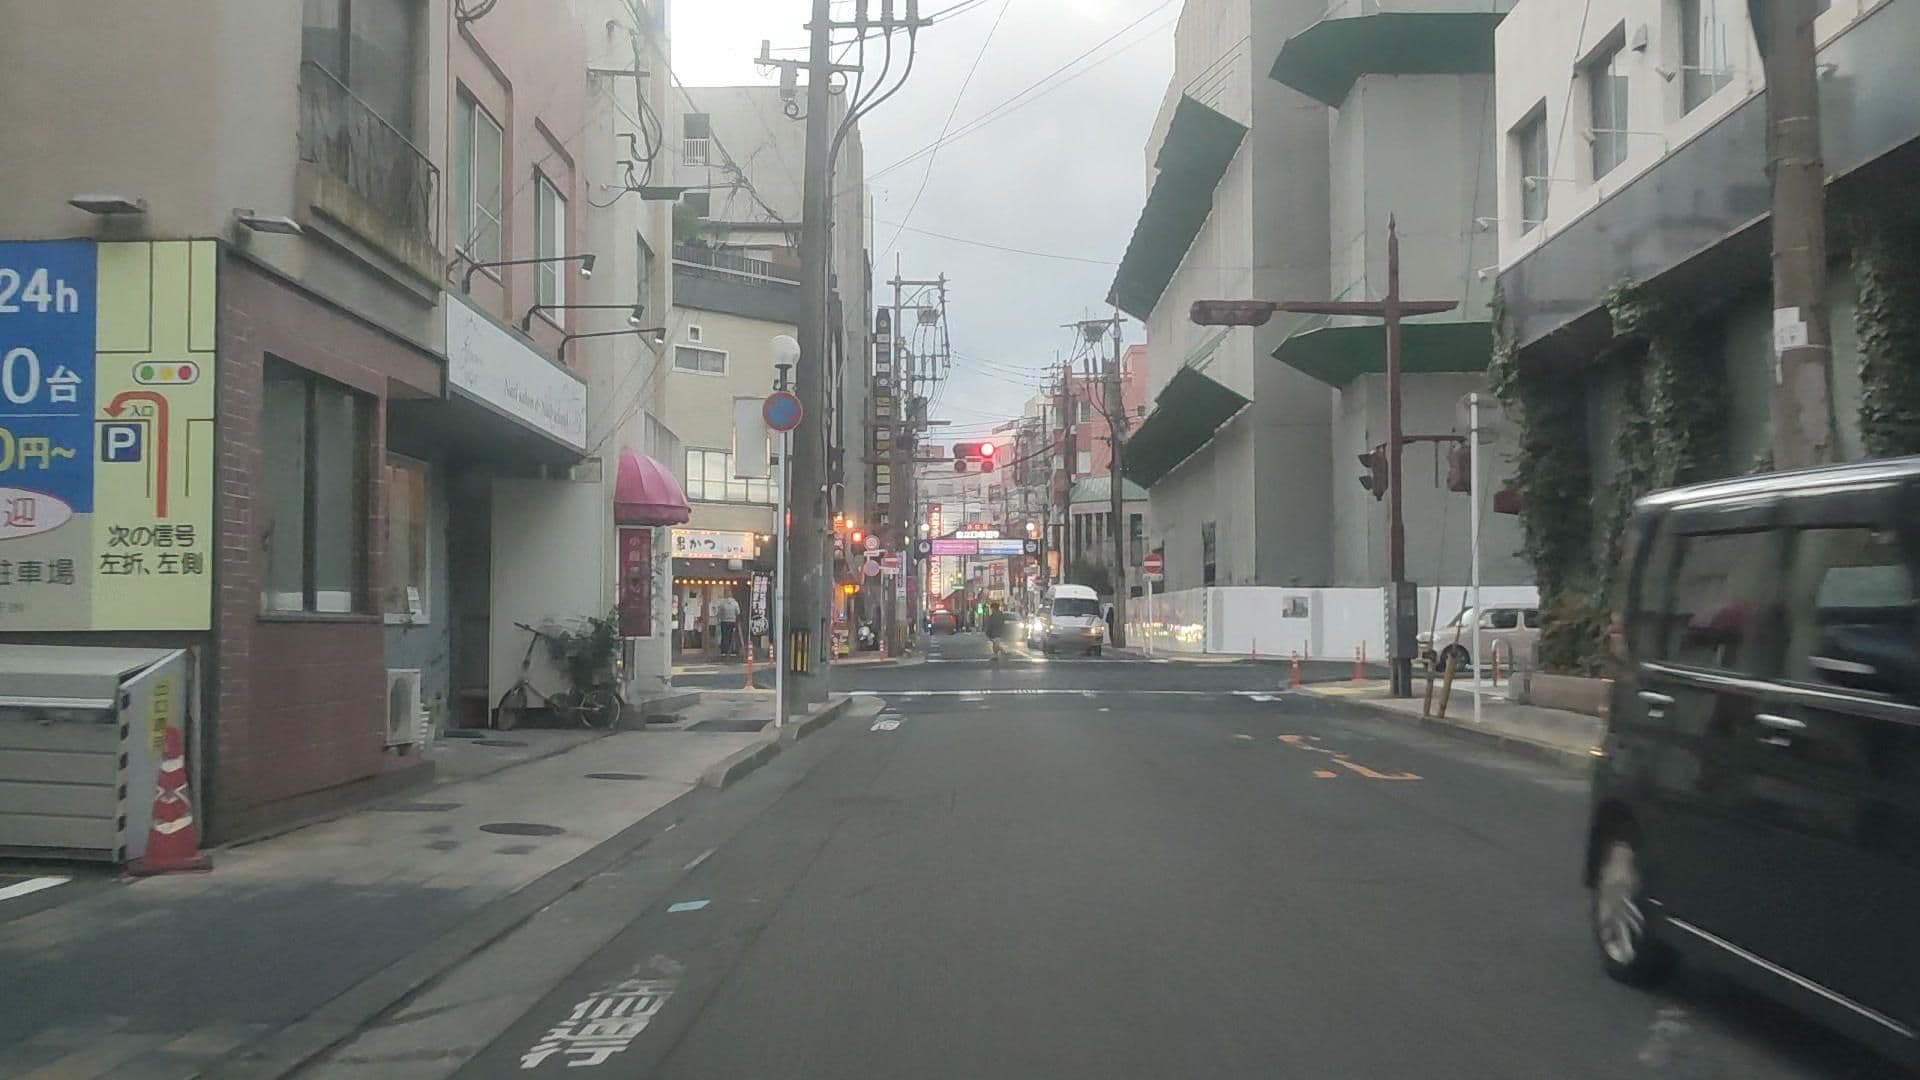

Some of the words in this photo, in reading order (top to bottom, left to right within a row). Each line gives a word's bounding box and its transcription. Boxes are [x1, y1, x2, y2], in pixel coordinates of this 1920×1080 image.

[0, 267, 79, 313] 24h
[2, 347, 82, 404] 0台
[130, 405, 154, 416] 入口
[108, 427, 136, 459] P
[108, 524, 196, 547] 次の信号
[676, 535, 717, 552] 串かつ
[100, 551, 203, 575] 左折、左側
